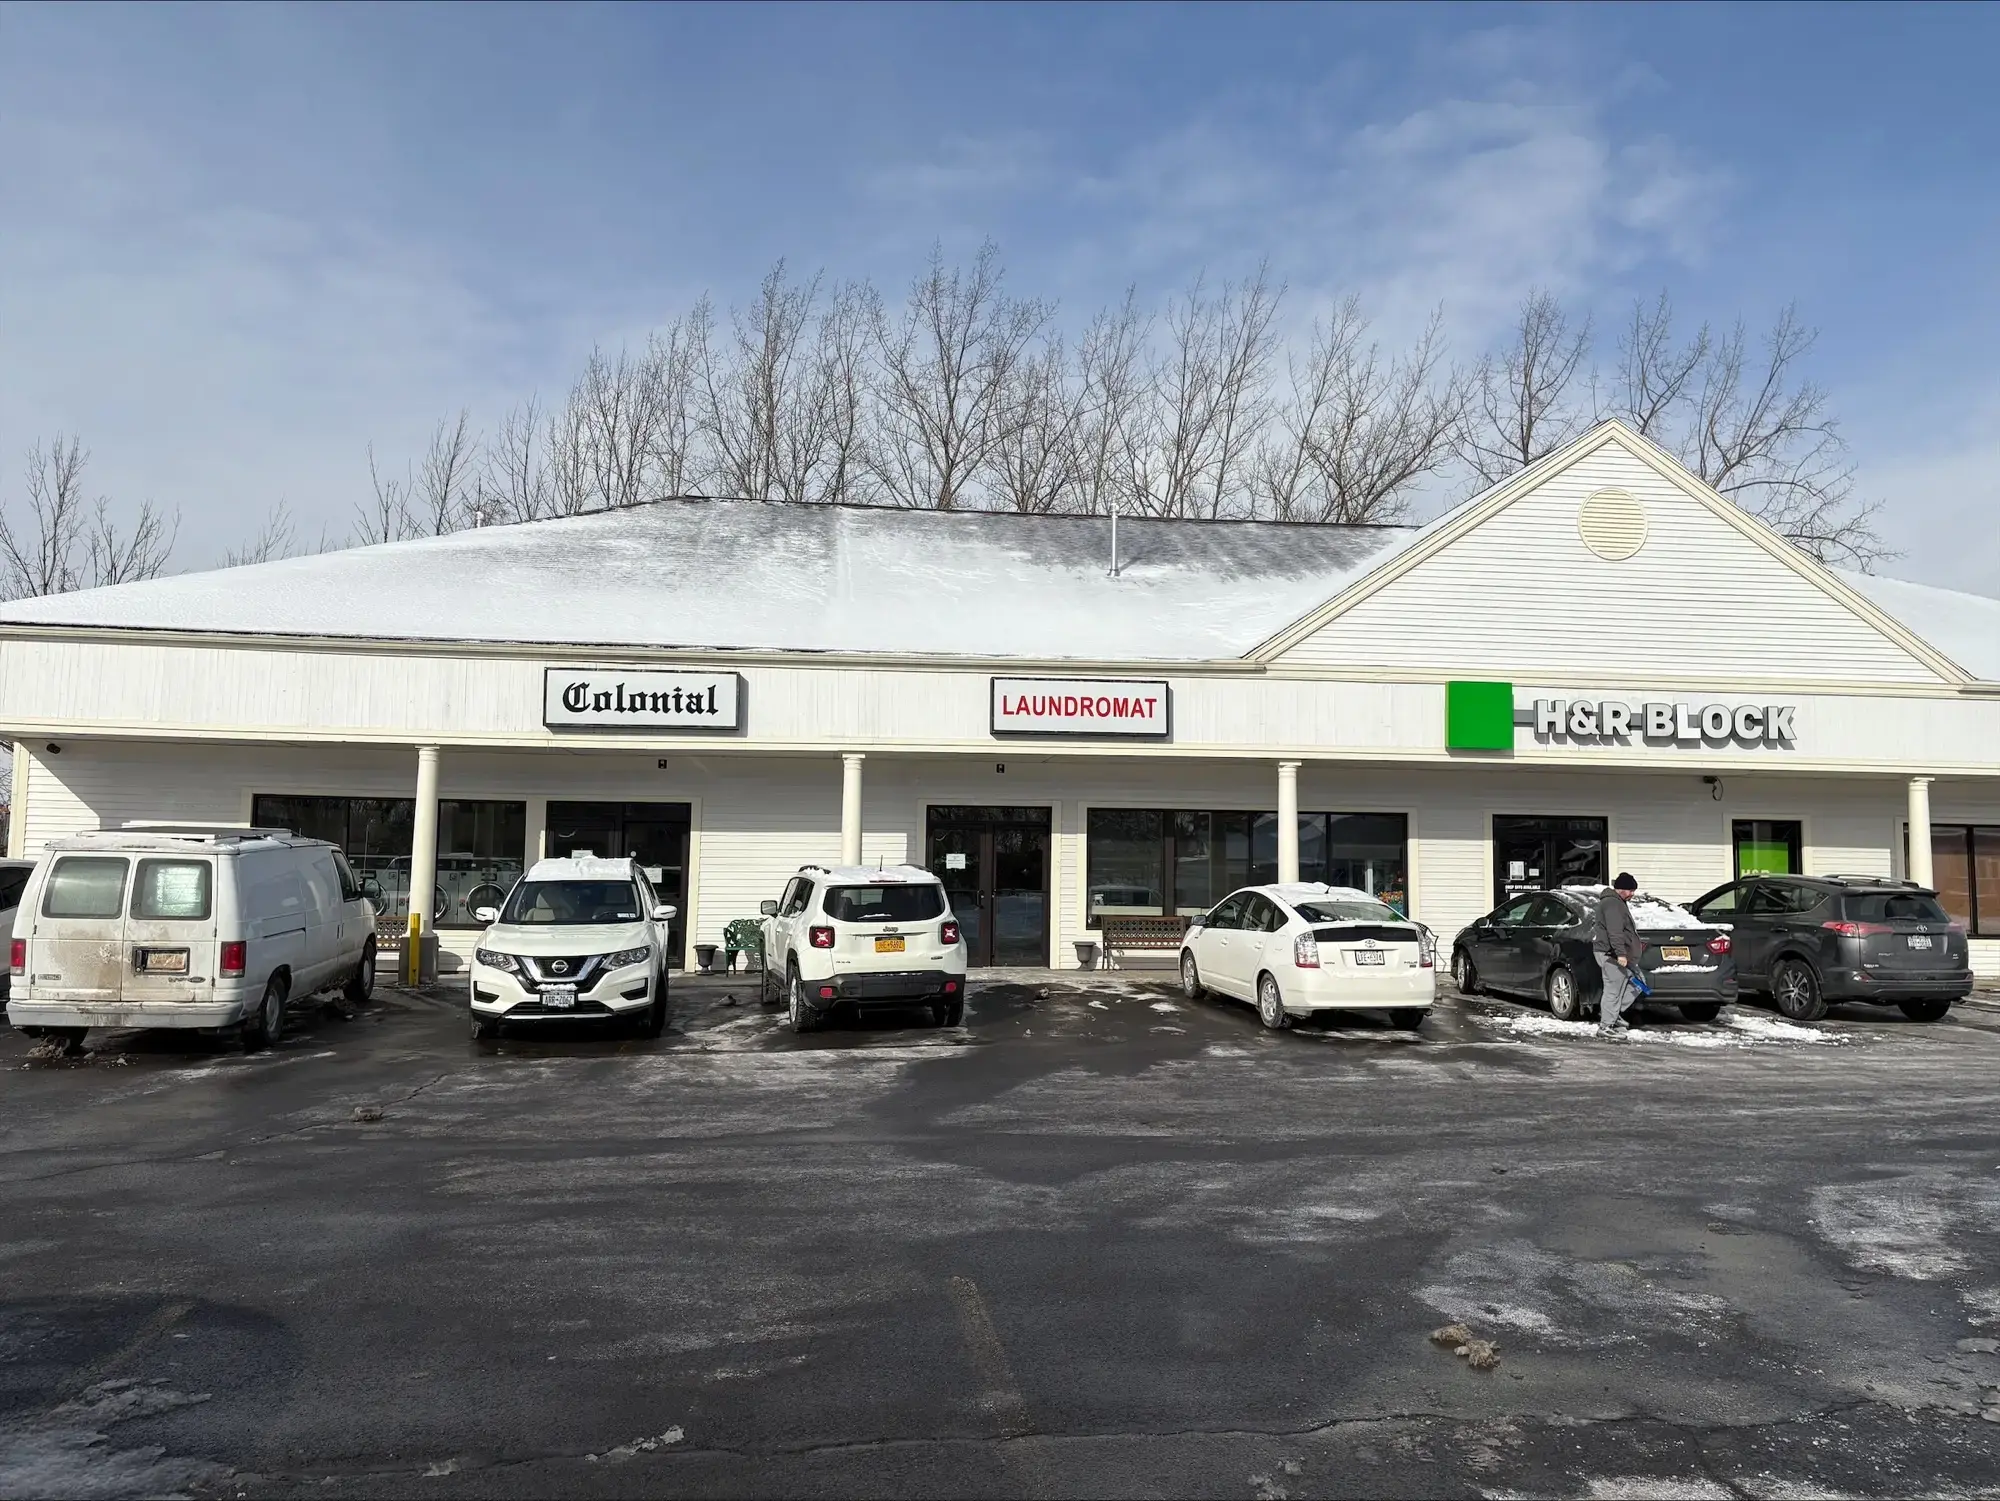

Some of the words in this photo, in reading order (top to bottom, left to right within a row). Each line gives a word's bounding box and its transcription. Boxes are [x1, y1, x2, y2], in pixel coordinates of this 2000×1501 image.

[562, 682, 719, 715] Colonial
[1002, 695, 1157, 718] LAUNDROMAT
[1534, 699, 1632, 737] H&R
[1642, 702, 1796, 741] BLOCK
